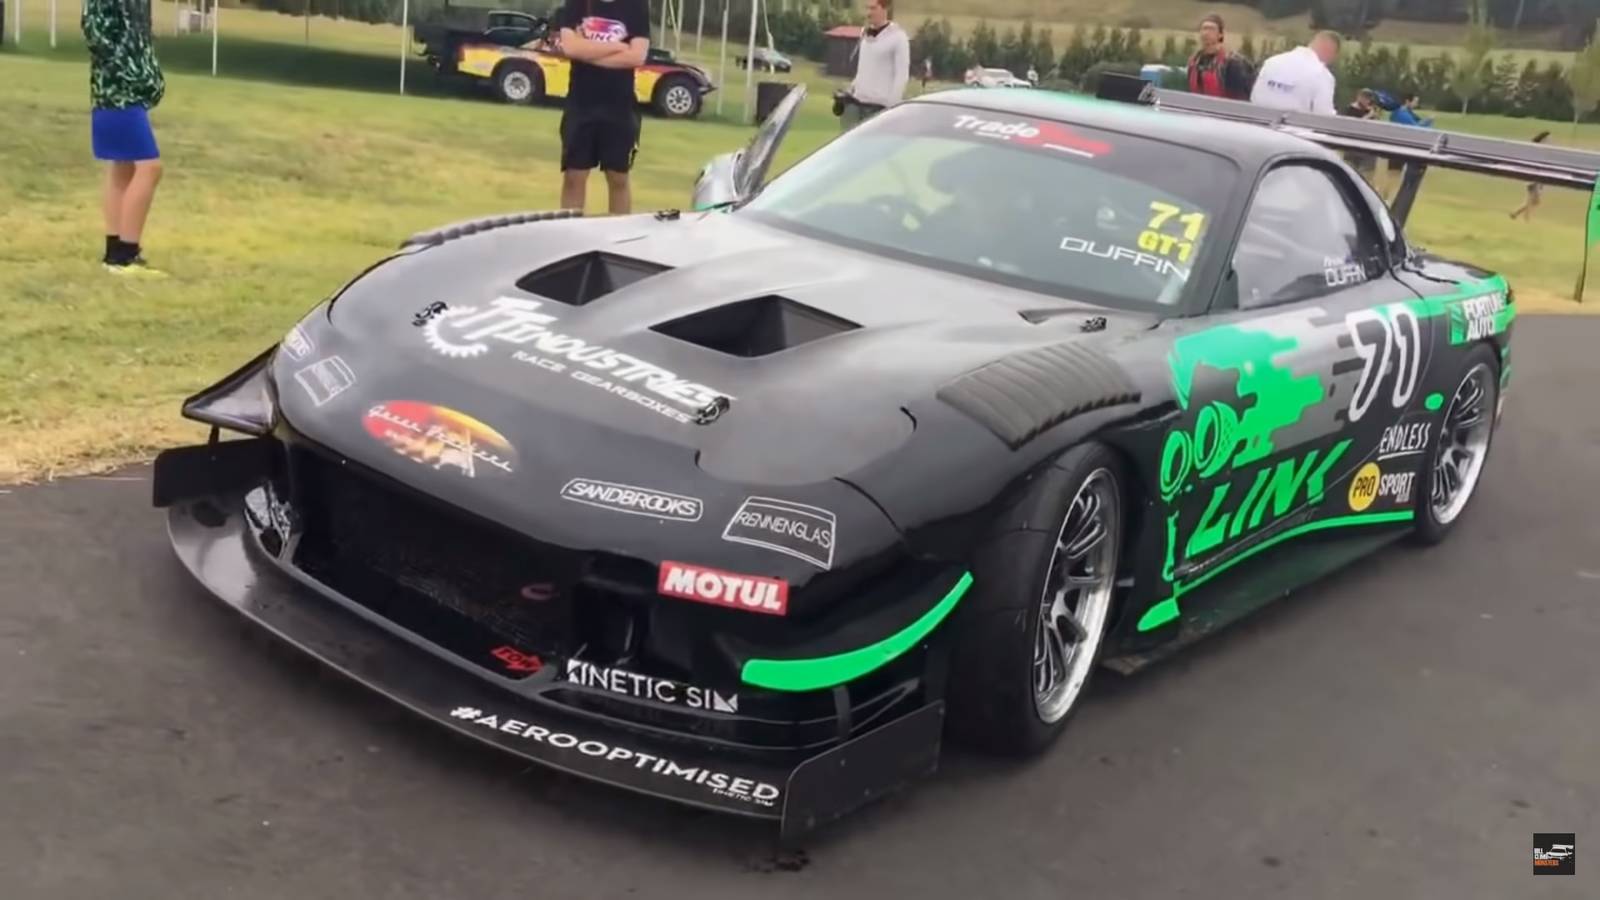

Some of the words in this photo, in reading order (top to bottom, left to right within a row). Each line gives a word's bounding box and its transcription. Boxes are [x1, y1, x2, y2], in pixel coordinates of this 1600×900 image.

[1148, 200, 1206, 242] 71
[1059, 236, 1191, 282] DUFFIN
[1137, 229, 1193, 264] GT1
[511, 350, 567, 374] RACE
[569, 370, 691, 424] GEARBOXES
[1380, 422, 1432, 454] ENDLESS
[568, 482, 698, 517] SANDBROOKS
[1185, 438, 1354, 560] LINK
[1352, 475, 1377, 499] PRO
[1378, 471, 1416, 499] SPORT
[736, 510, 831, 549] RENNENGLAS
[664, 567, 783, 611] MOTUL
[567, 658, 676, 703] KINETIC
[687, 687, 738, 712] SIM
[450, 706, 780, 801] #AEROOPTIMISED
